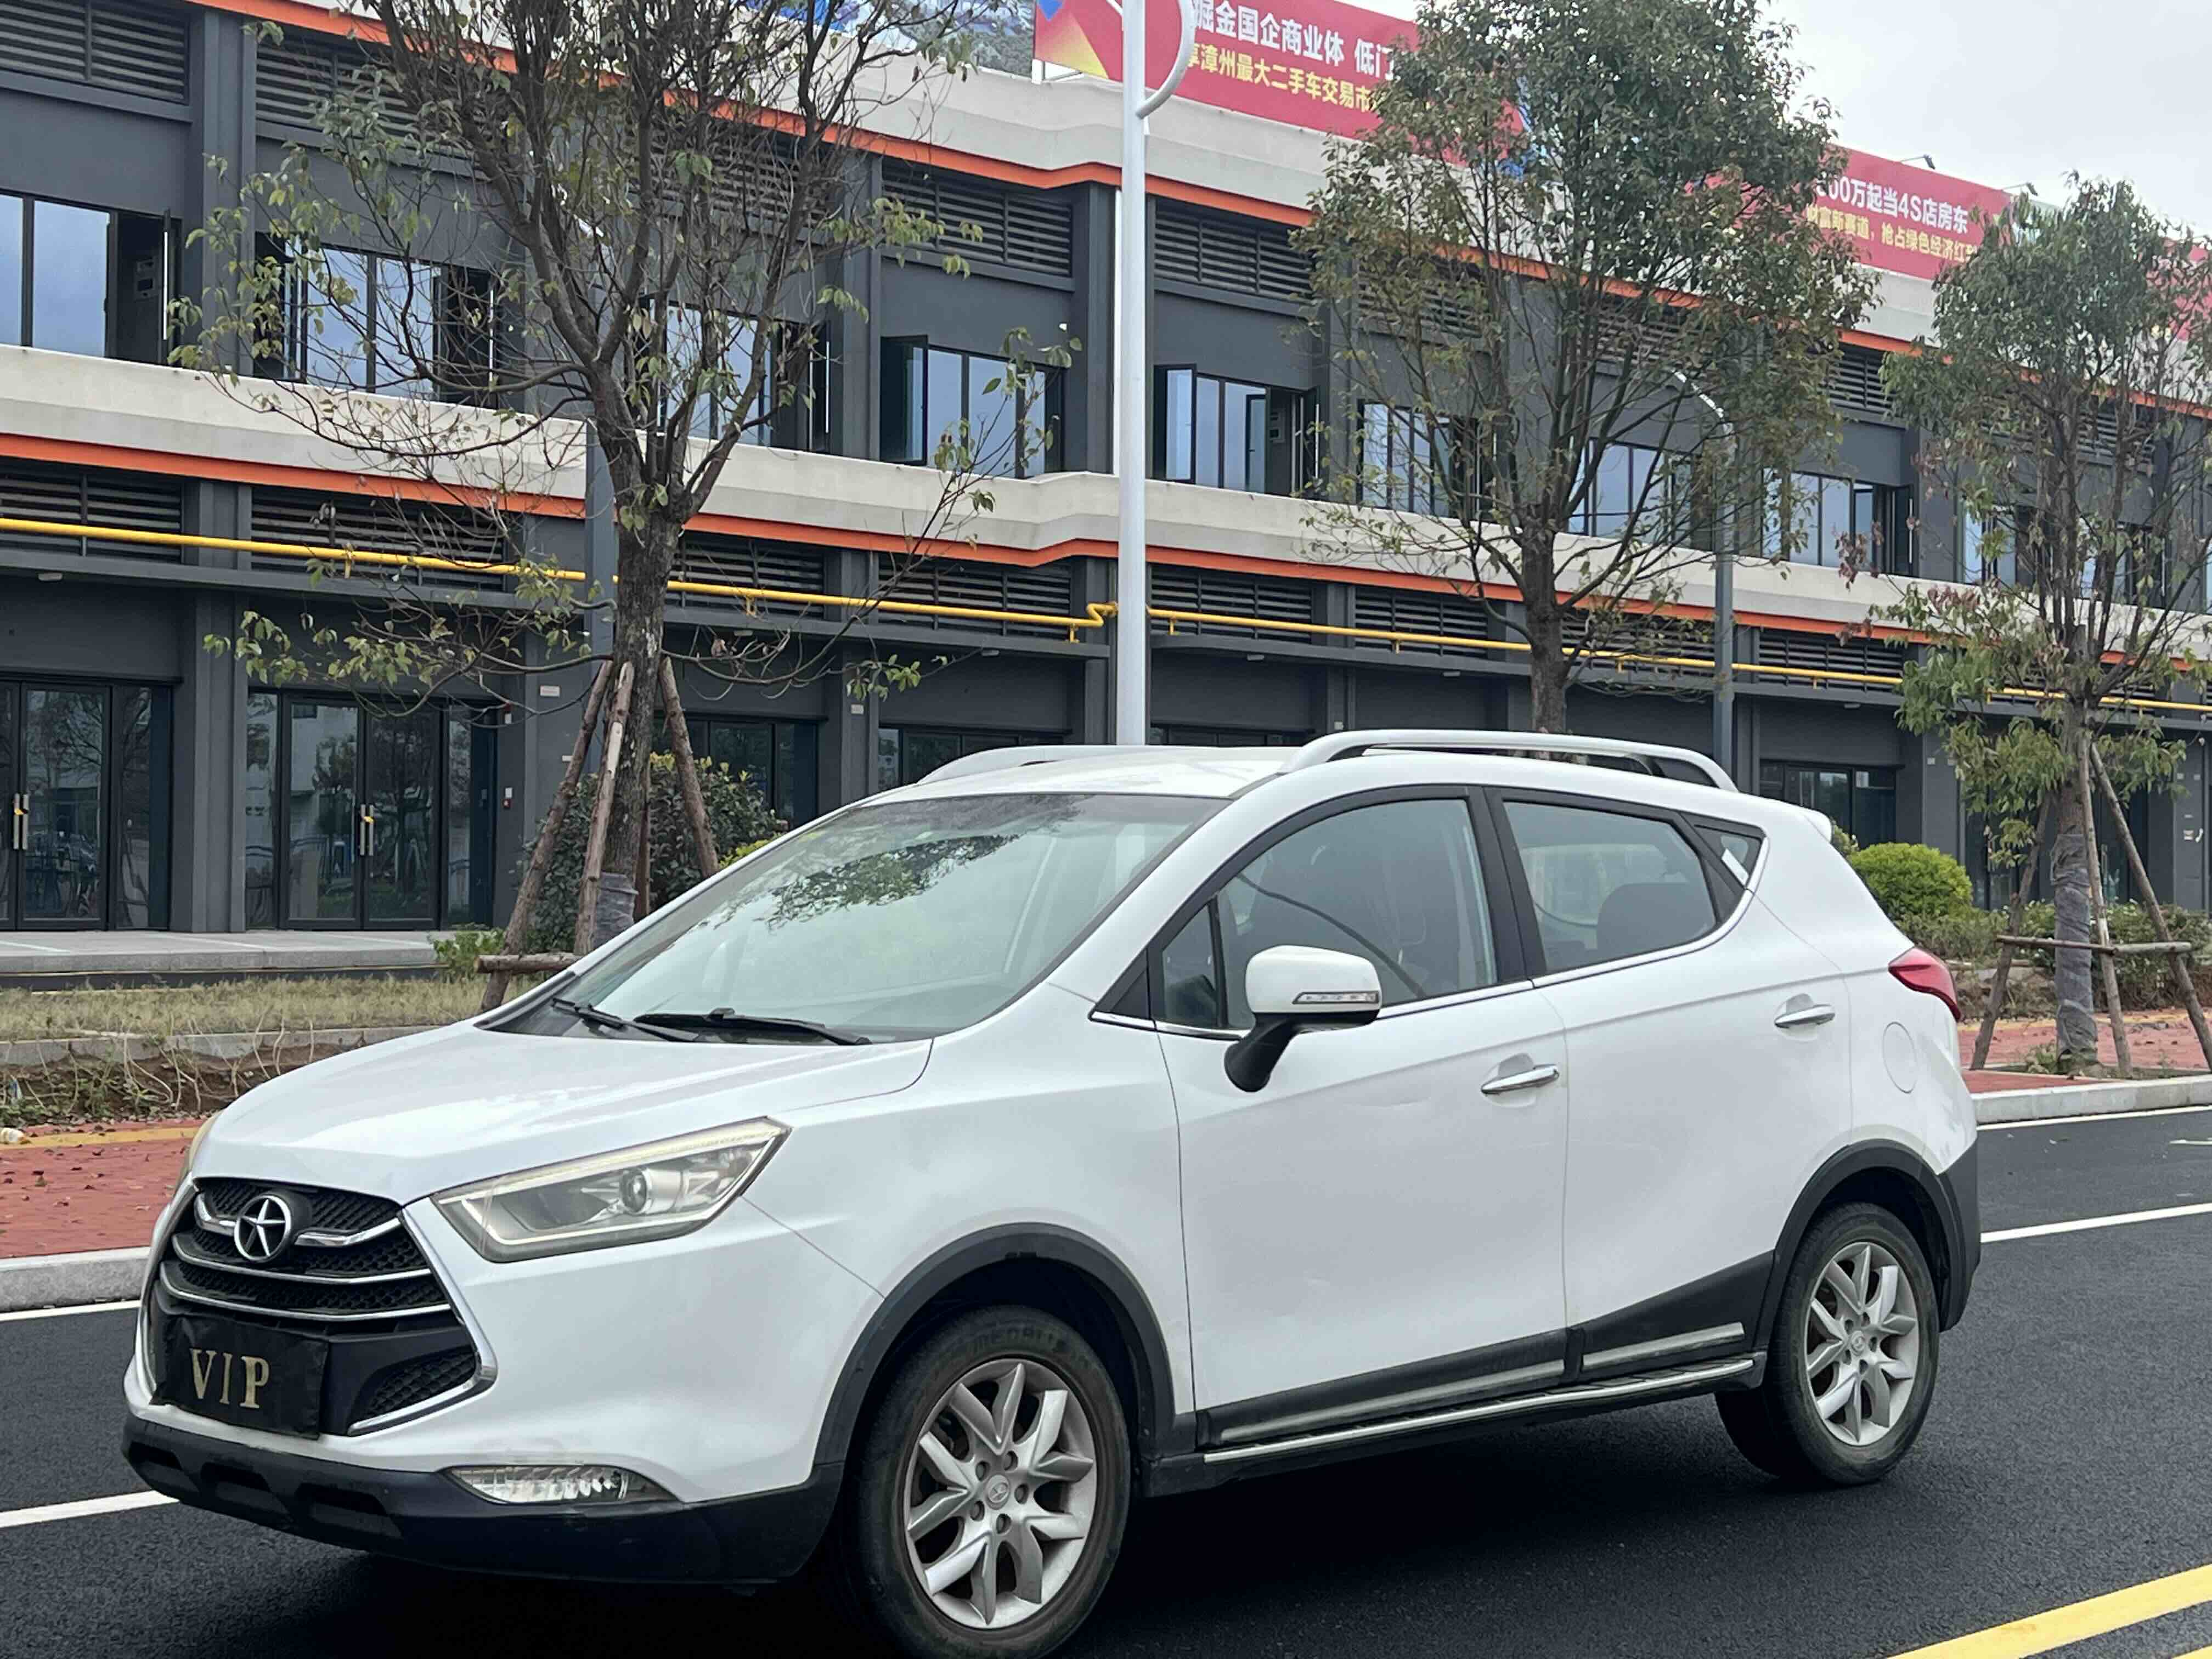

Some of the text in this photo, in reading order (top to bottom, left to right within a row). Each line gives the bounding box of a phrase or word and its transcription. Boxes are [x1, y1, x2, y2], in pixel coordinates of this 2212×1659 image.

[1188, 43, 1378, 112] 享漳州最大二手车交易市
[189, 1347, 271, 1409] VIP
